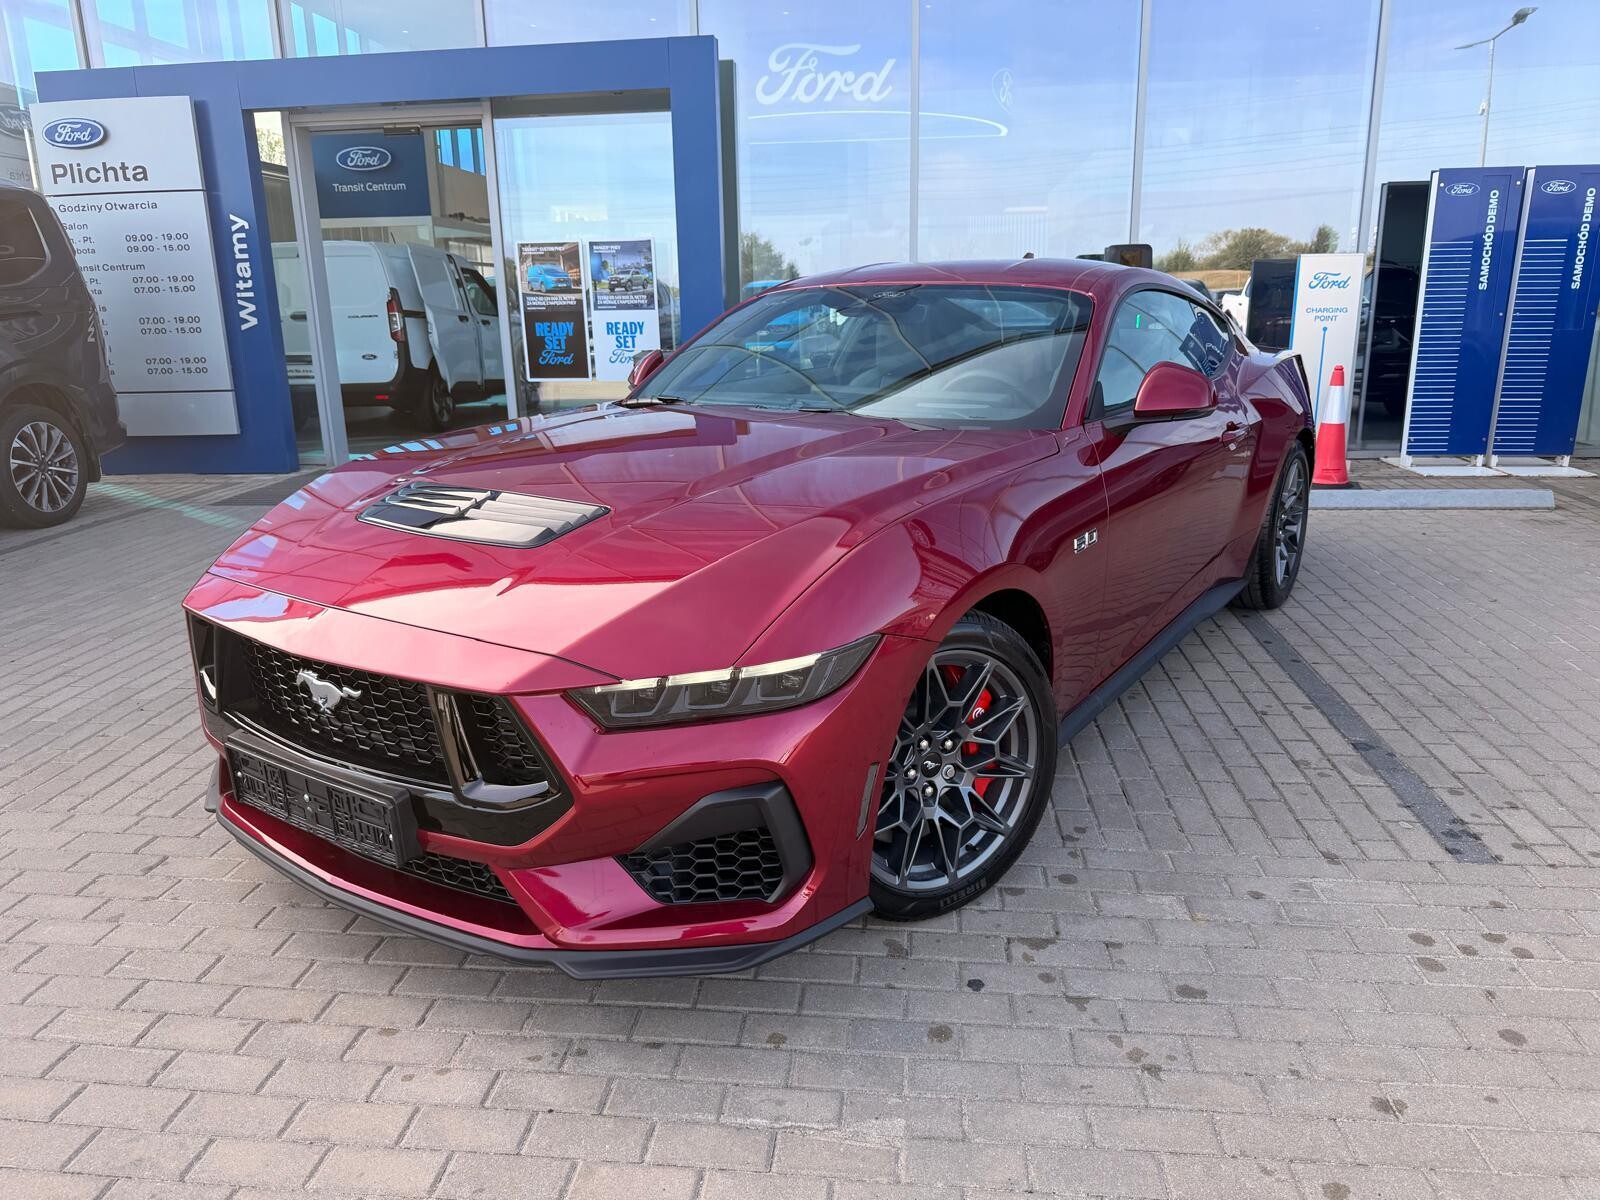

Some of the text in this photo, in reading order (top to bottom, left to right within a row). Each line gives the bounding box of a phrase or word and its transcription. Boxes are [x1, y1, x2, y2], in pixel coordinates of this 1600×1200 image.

[755, 43, 897, 105] Ford
[54, 123, 93, 142] Ford
[347, 150, 380, 167] Ford
[51, 162, 149, 184] Plichta
[332, 182, 406, 192] Transit Centrum
[58, 201, 158, 213] Godziny Otwarcia
[82, 236, 95, 244] Pt.
[125, 234, 153, 242] 09.00
[161, 232, 189, 241] 19.00
[1478, 189, 1499, 290] SAMOCHÓD DEMO
[1571, 187, 1596, 289] SAMOCHÓD DEMO
[126, 245, 155, 253] 09.00
[163, 243, 190, 252] 15.00
[102, 263, 146, 271] Centrum
[229, 213, 258, 331] Witamy
[132, 276, 159, 284] 07.00
[167, 274, 195, 283] 19.00
[1308, 271, 1351, 289] Ford
[133, 286, 161, 294] 07.00
[169, 284, 196, 293] 15.00
[1305, 306, 1348, 314] CHARGING
[138, 316, 166, 325] 07.00
[173, 315, 201, 324] 19.00
[140, 327, 167, 335] 07.00
[175, 326, 202, 334] 15.00
[535, 321, 574, 336] READY
[606, 321, 645, 335] READY
[544, 336, 566, 350] SET
[615, 335, 636, 348] SET
[145, 357, 172, 365] 07.00
[180, 356, 207, 364] 19.00
[538, 349, 574, 365] Ford
[609, 349, 634, 364] For
[147, 367, 174, 375] 07.00
[181, 366, 208, 374] 15.00
